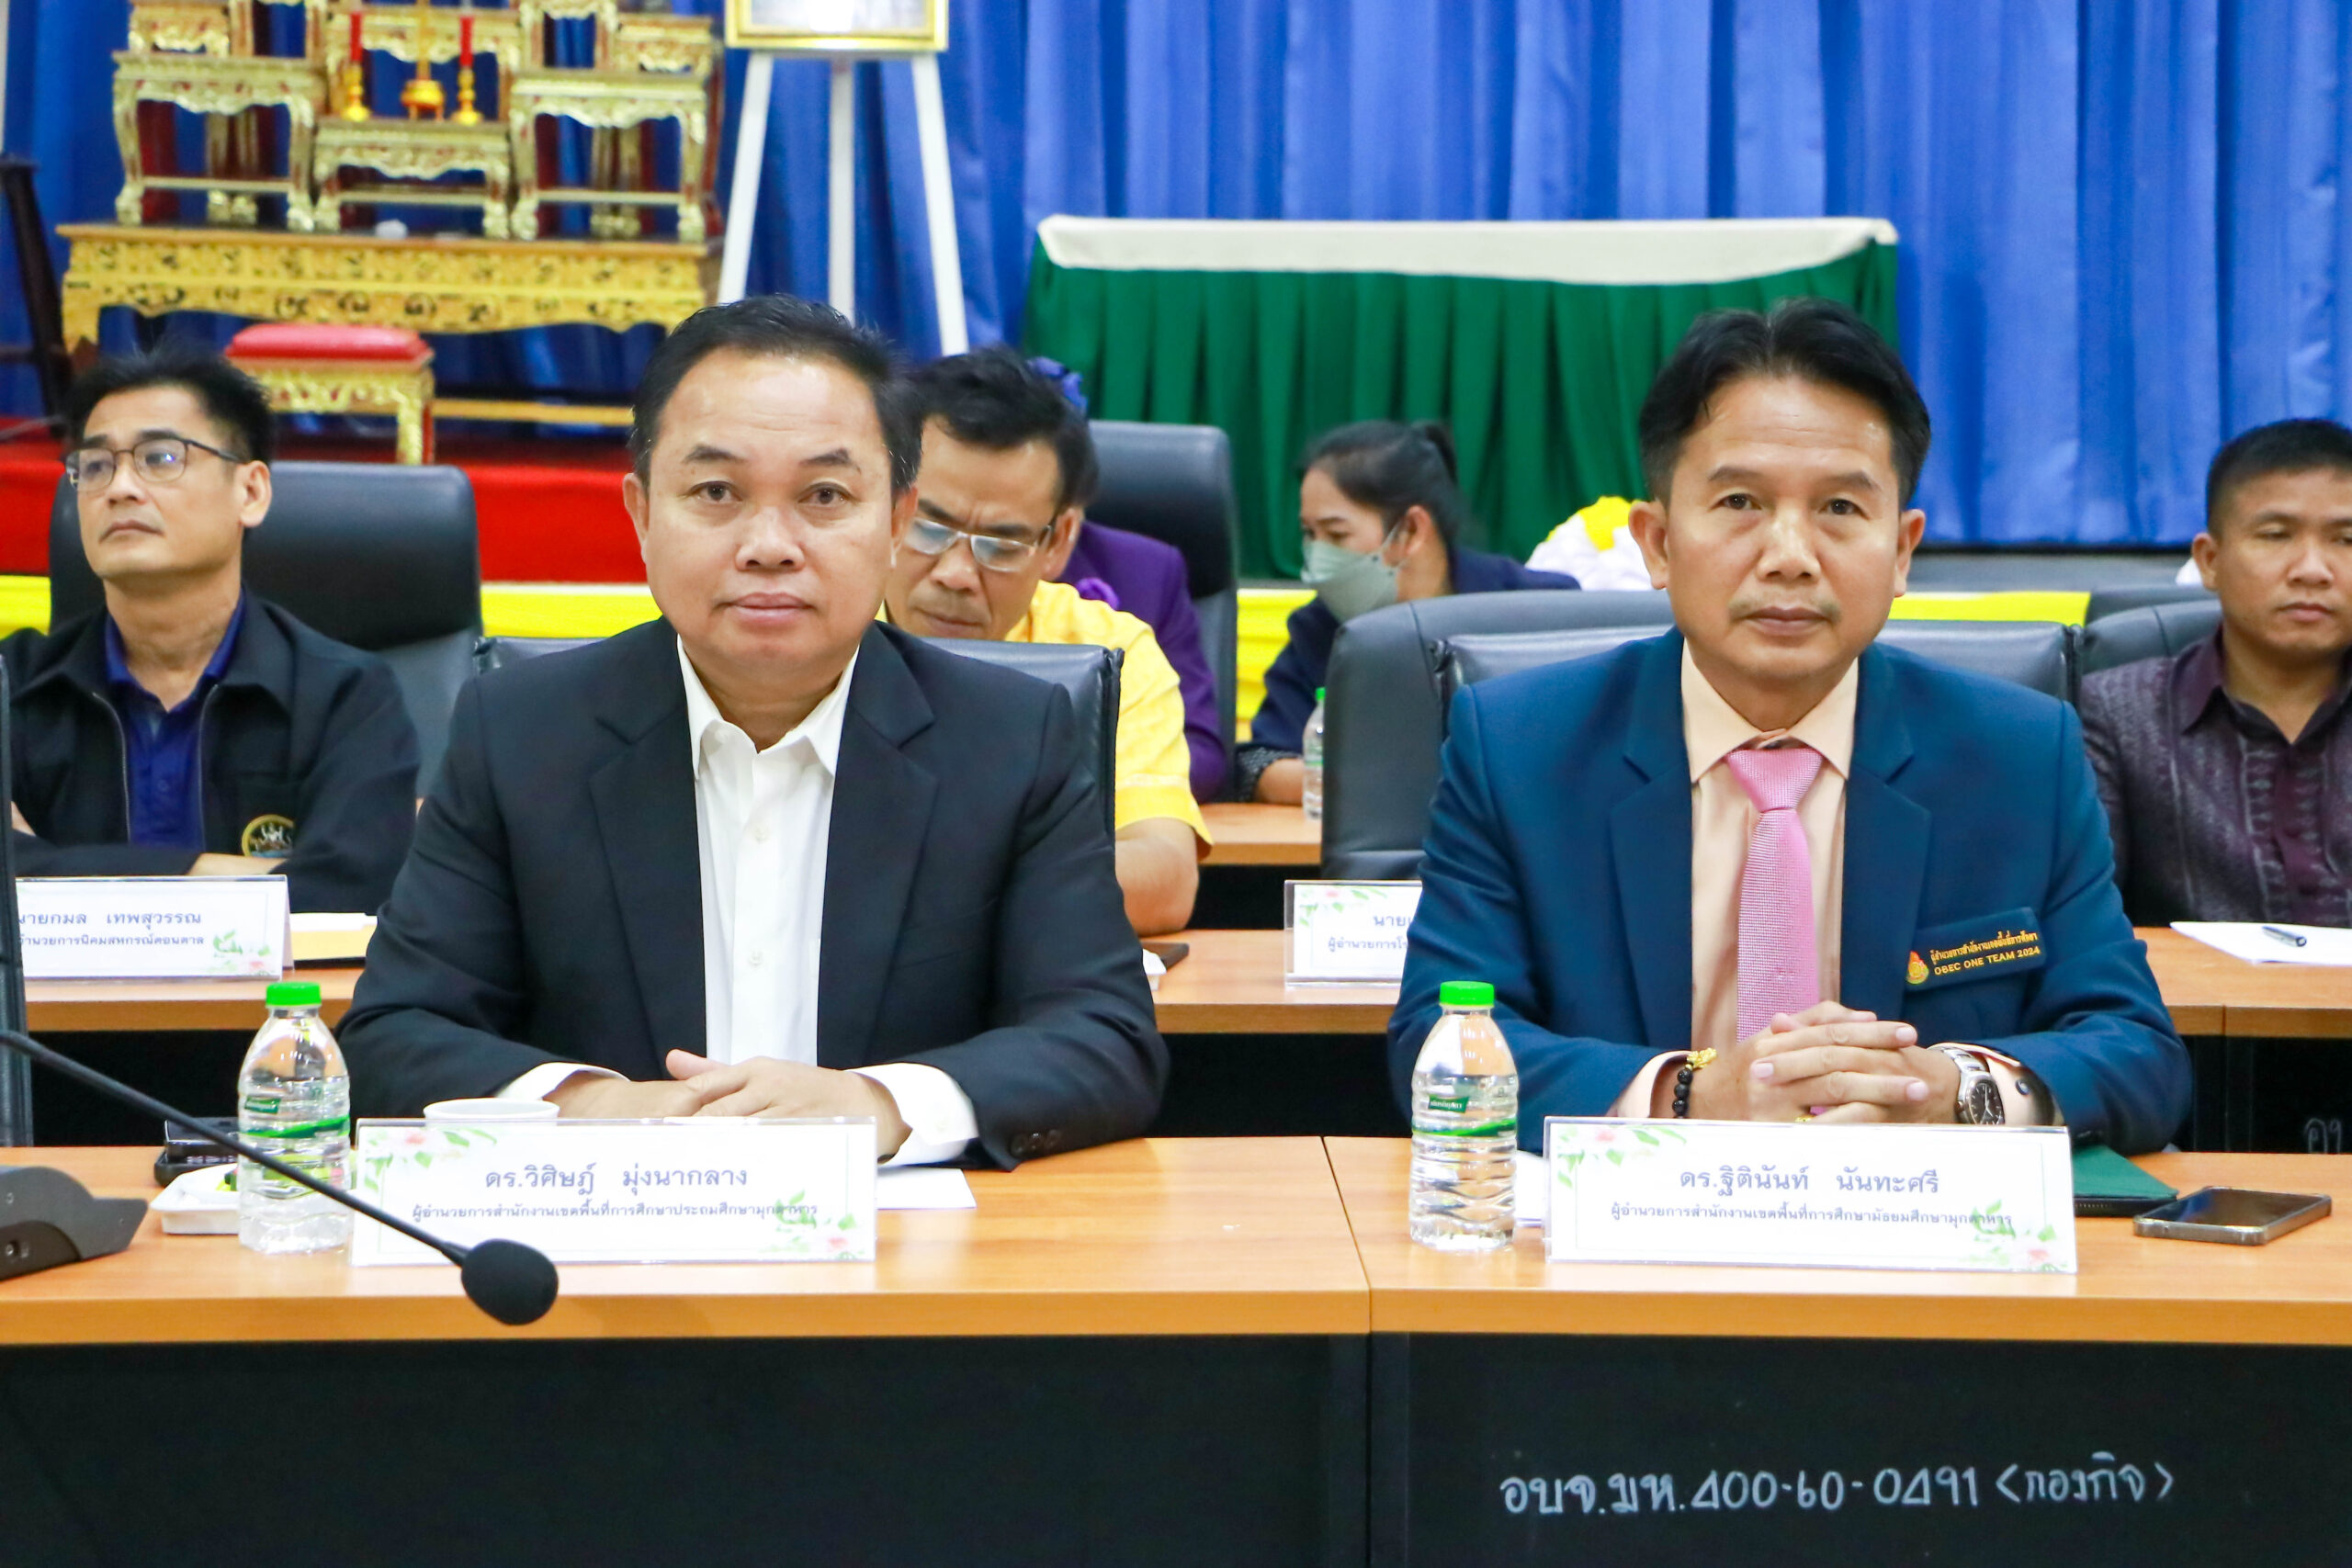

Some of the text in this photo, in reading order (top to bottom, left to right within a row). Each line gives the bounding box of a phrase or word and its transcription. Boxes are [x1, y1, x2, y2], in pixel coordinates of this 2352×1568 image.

[107, 912, 201, 931] เทพสุวรรณ
[1934, 946, 2041, 976] OBEC ONE TEAM 2024
[622, 1162, 747, 1197] มุ่งนากลาง
[1679, 1164, 1939, 1197] ดร.ฐิตินันท์ นันทะศรี
